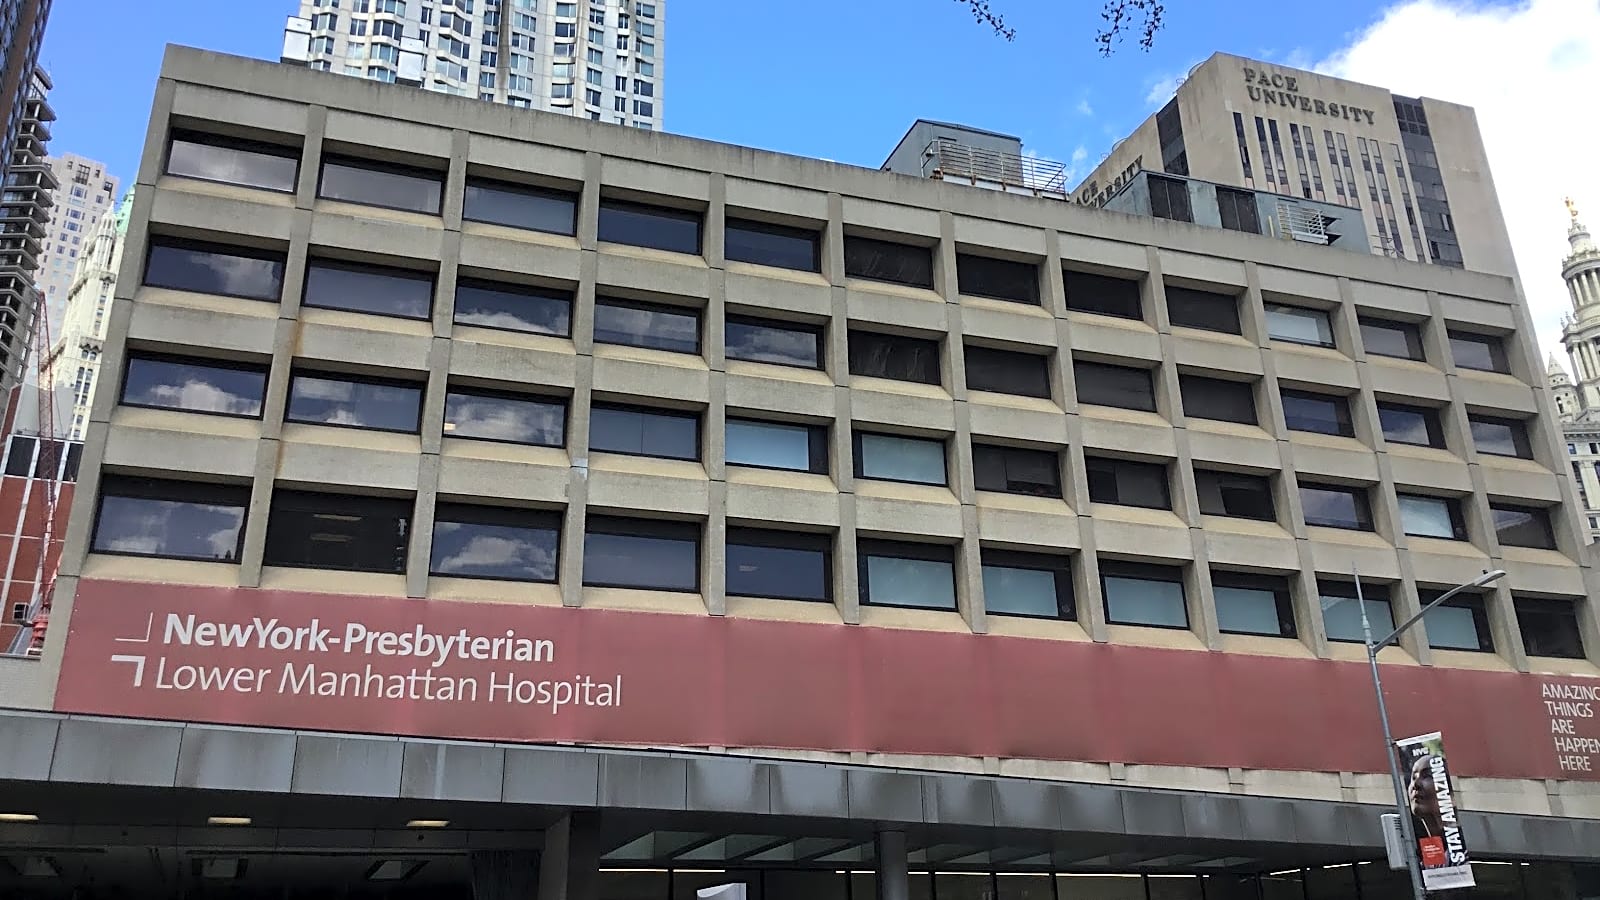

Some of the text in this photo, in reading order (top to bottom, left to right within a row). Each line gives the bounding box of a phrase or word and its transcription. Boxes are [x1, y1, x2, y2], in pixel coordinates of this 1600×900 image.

[1244, 68, 1298, 92] PACE
[1247, 85, 1375, 124] UNIVERSITY
[1076, 180, 1098, 205] ACE
[1089, 154, 1143, 208] VERSITY
[163, 613, 554, 667] NewYork-Presbyterian
[156, 656, 622, 715] Lower Manhattan Hospital
[1542, 683, 1600, 700] AMAZING
[1544, 701, 1594, 718] THINGS
[1552, 719, 1576, 735] ARE
[1559, 755, 1593, 771] HERE
[1429, 757, 1457, 823] AMAZING
[1443, 826, 1465, 863] STAY
